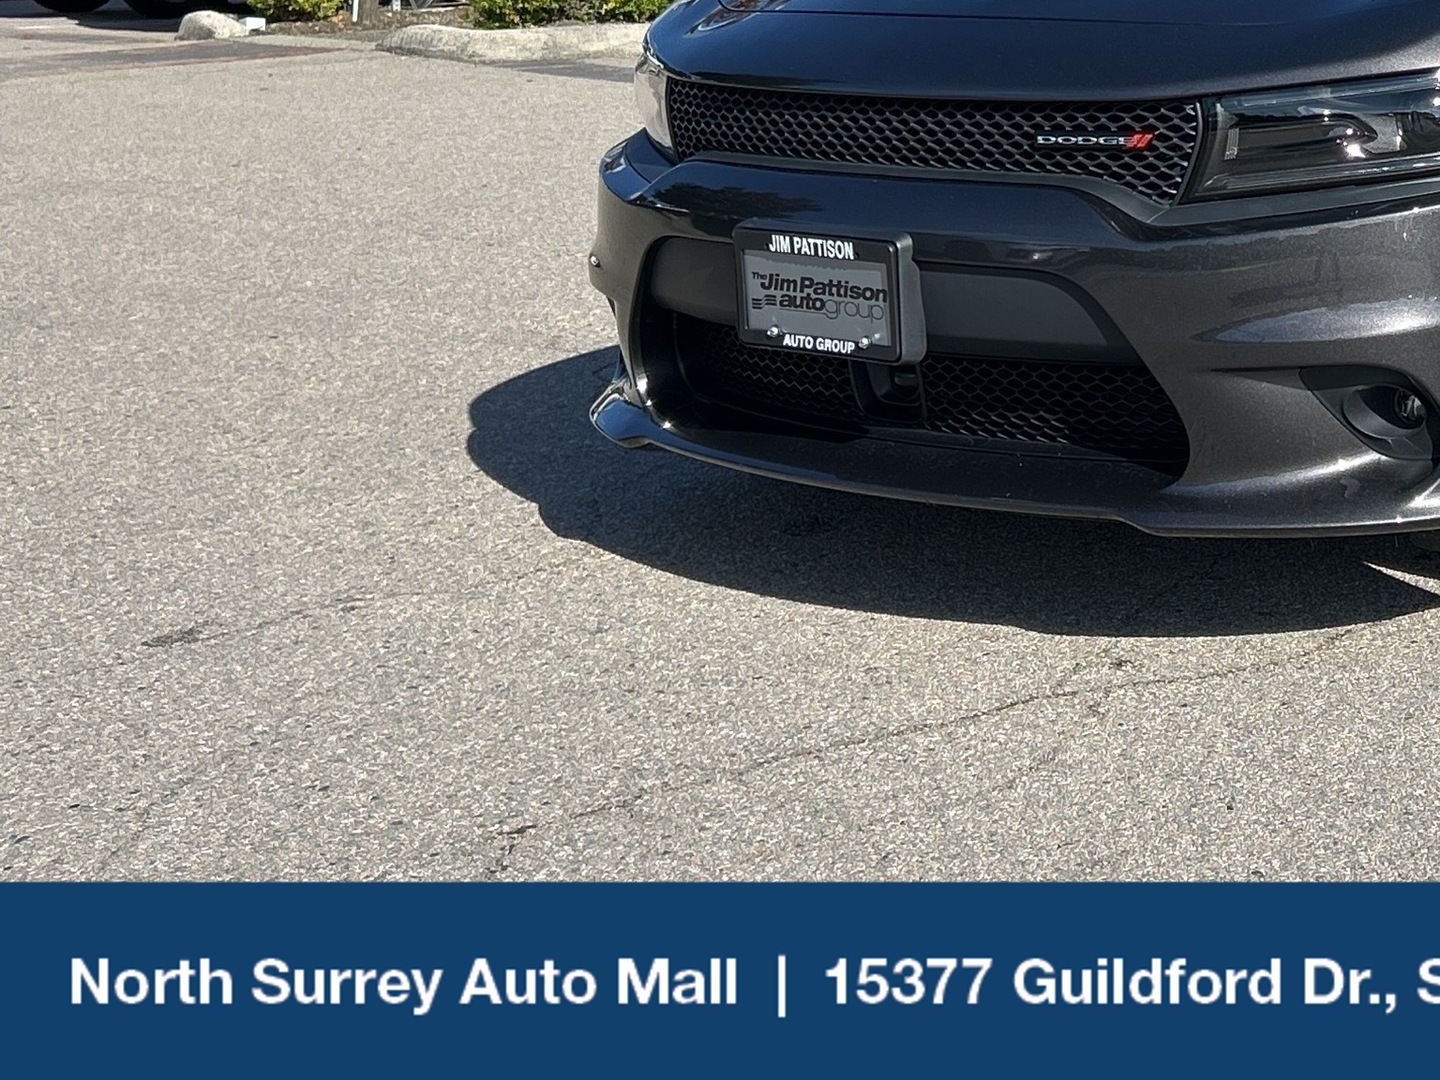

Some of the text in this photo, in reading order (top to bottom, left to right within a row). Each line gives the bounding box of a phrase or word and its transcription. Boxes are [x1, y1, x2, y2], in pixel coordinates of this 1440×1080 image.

[1036, 135, 1138, 146] DODGE
[768, 234, 855, 261] JIM PATTISON
[799, 276, 888, 303] Pattison
[782, 334, 856, 355] AUTO GROUP
